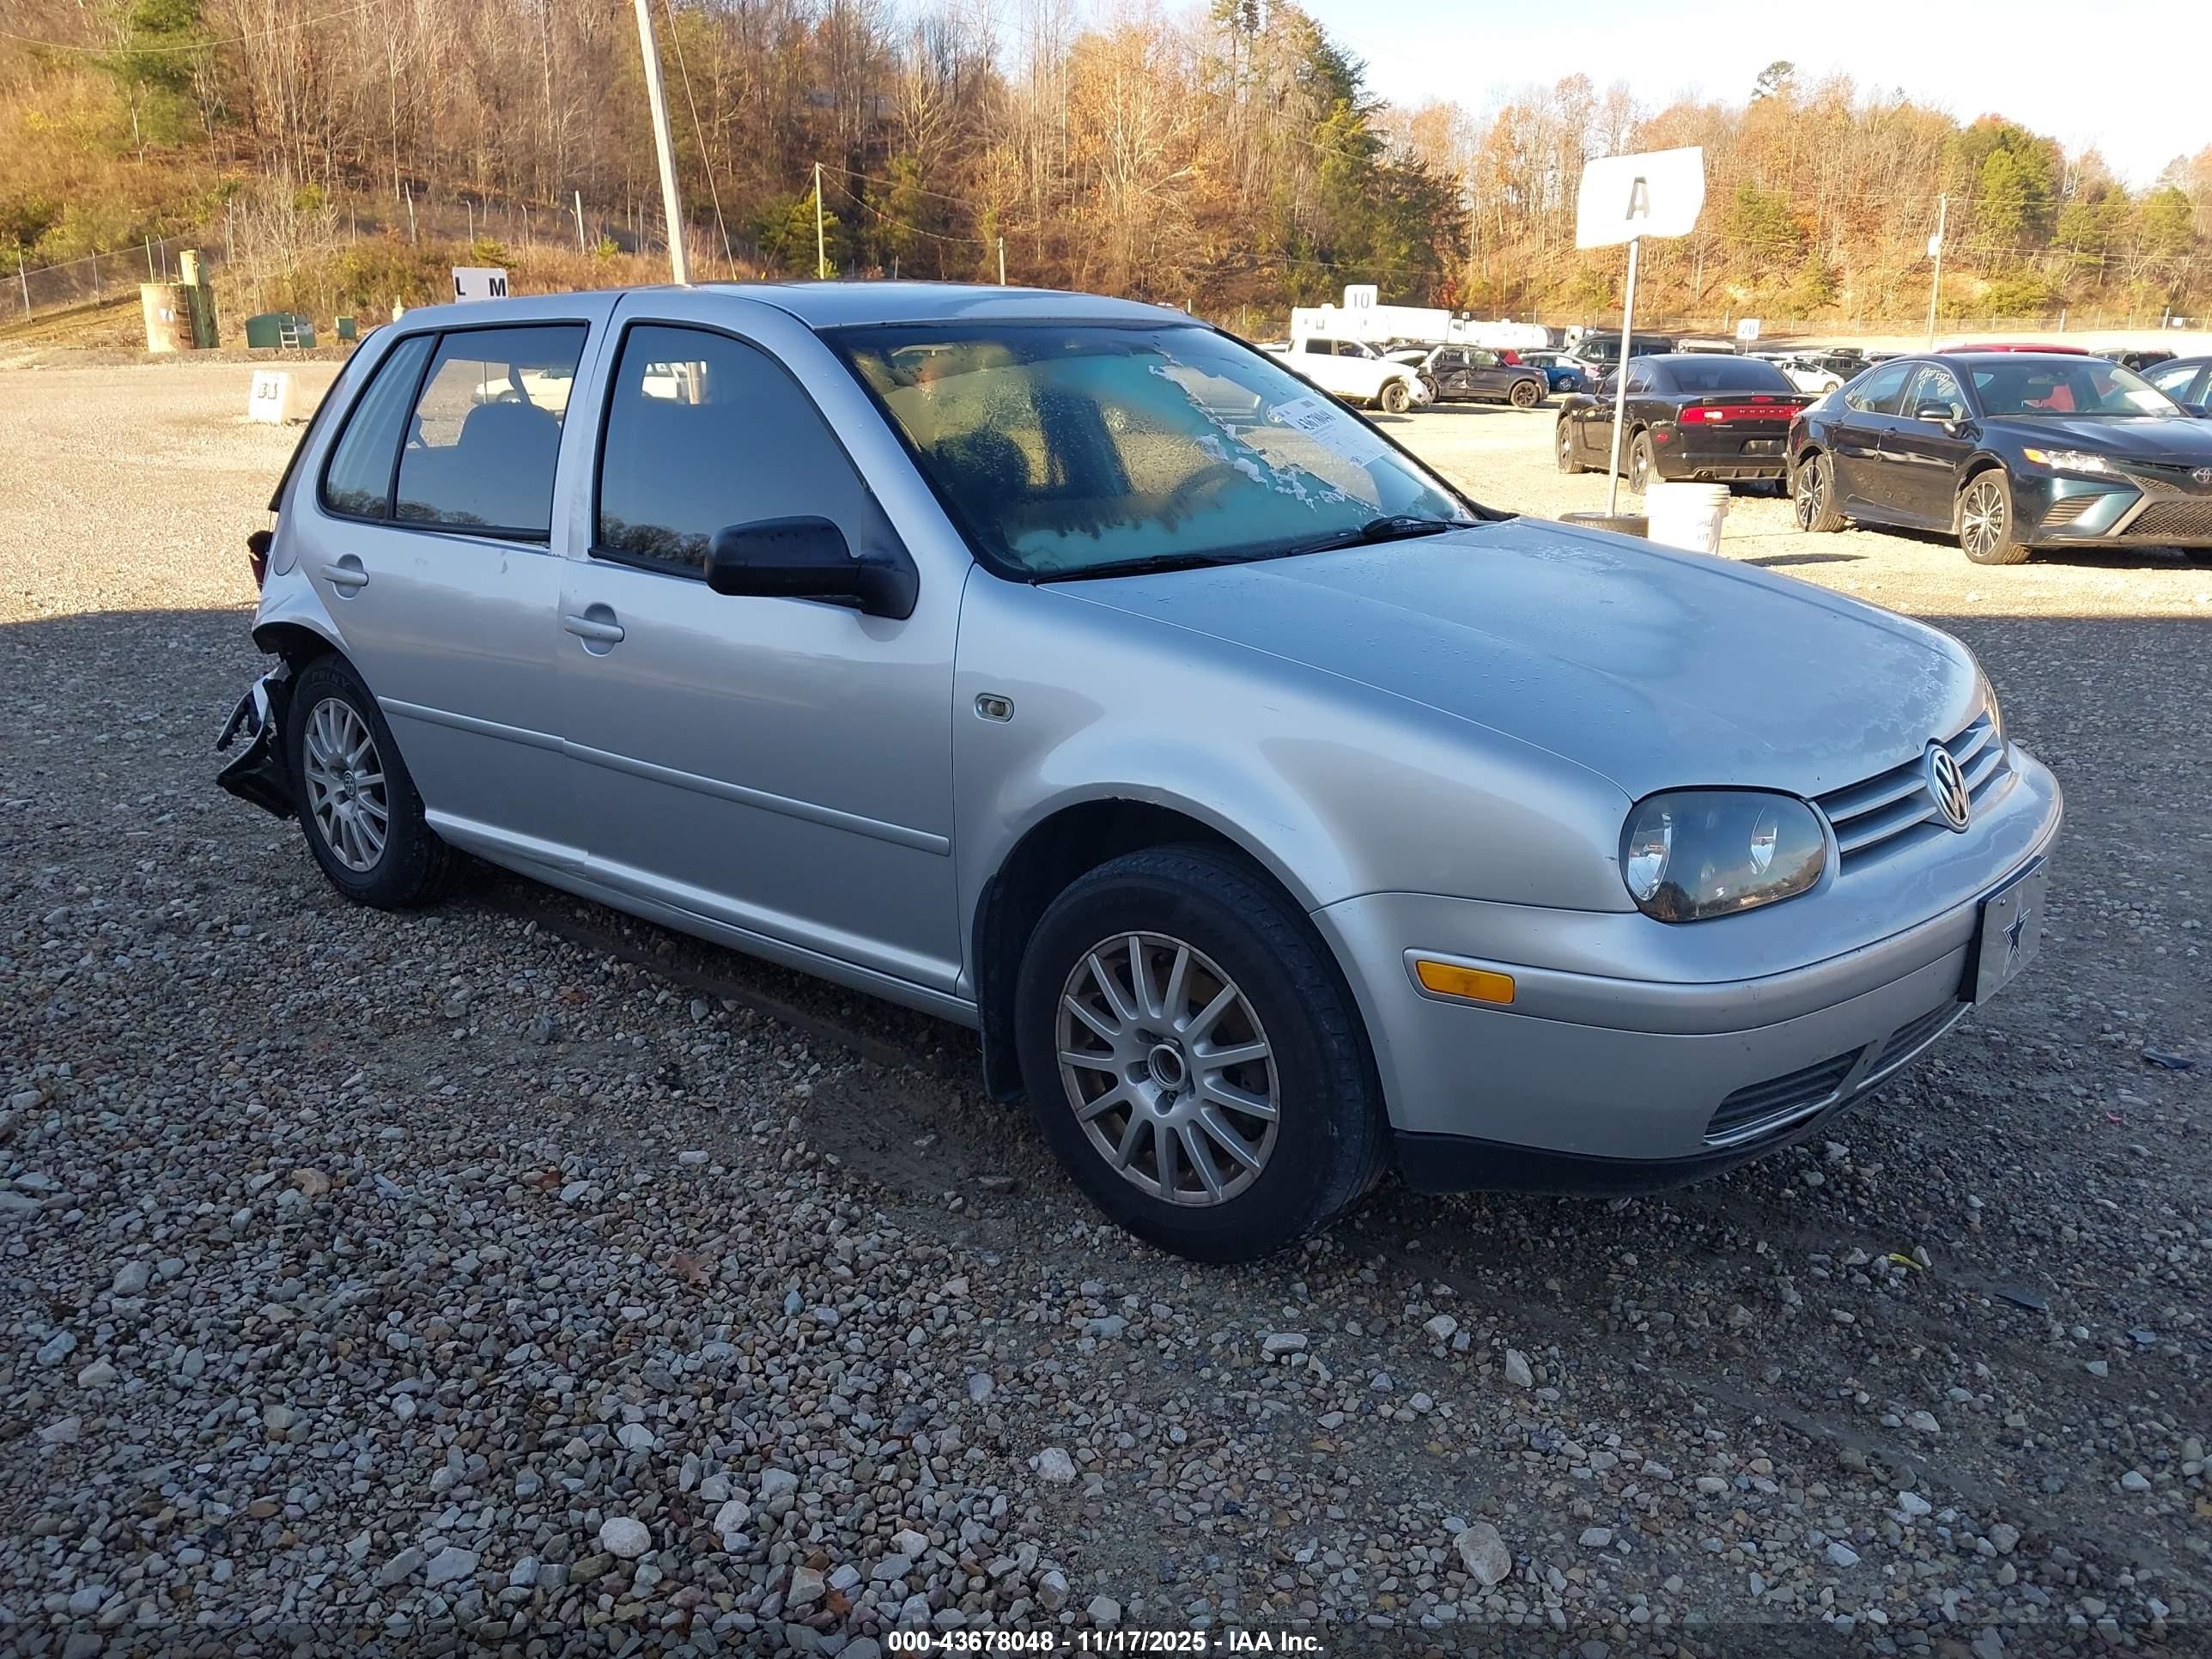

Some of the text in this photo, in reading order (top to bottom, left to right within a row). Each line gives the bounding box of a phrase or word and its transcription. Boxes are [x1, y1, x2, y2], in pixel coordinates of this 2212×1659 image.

[1626, 177, 1650, 221] A
[454, 276, 507, 297] L M
[1353, 292, 1370, 309] 10
